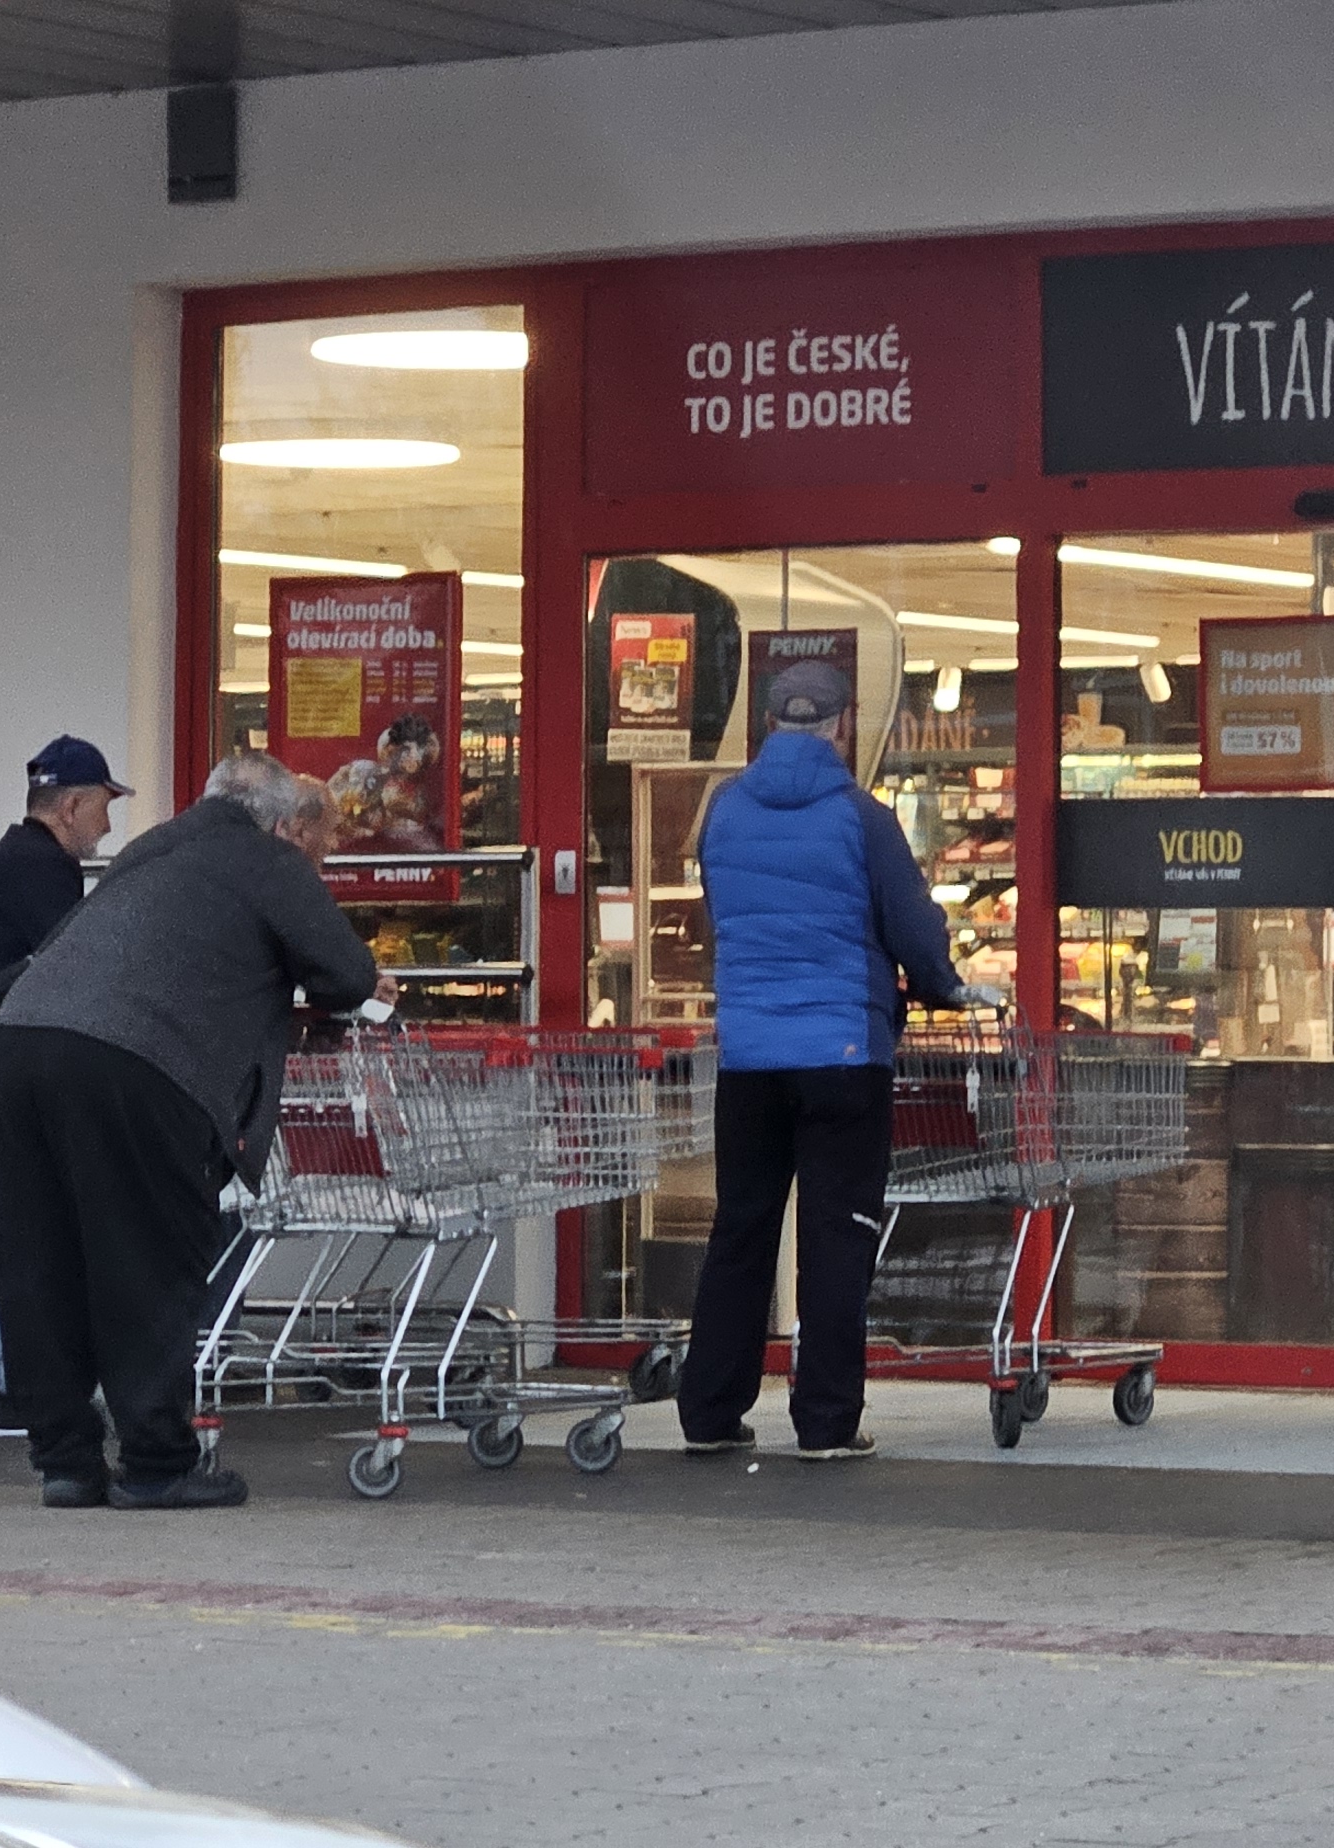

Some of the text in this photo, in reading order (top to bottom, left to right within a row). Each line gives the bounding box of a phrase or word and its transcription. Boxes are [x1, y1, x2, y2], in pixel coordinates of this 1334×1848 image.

[686, 323, 910, 385] CO JE ČESKÉ,
[684, 377, 912, 438] TO JE DOBRÉ
[289, 595, 413, 622] Velikonoční
[286, 622, 377, 650] otevírací
[1250, 648, 1302, 672] sport
[1158, 829, 1244, 864] VCHOD
